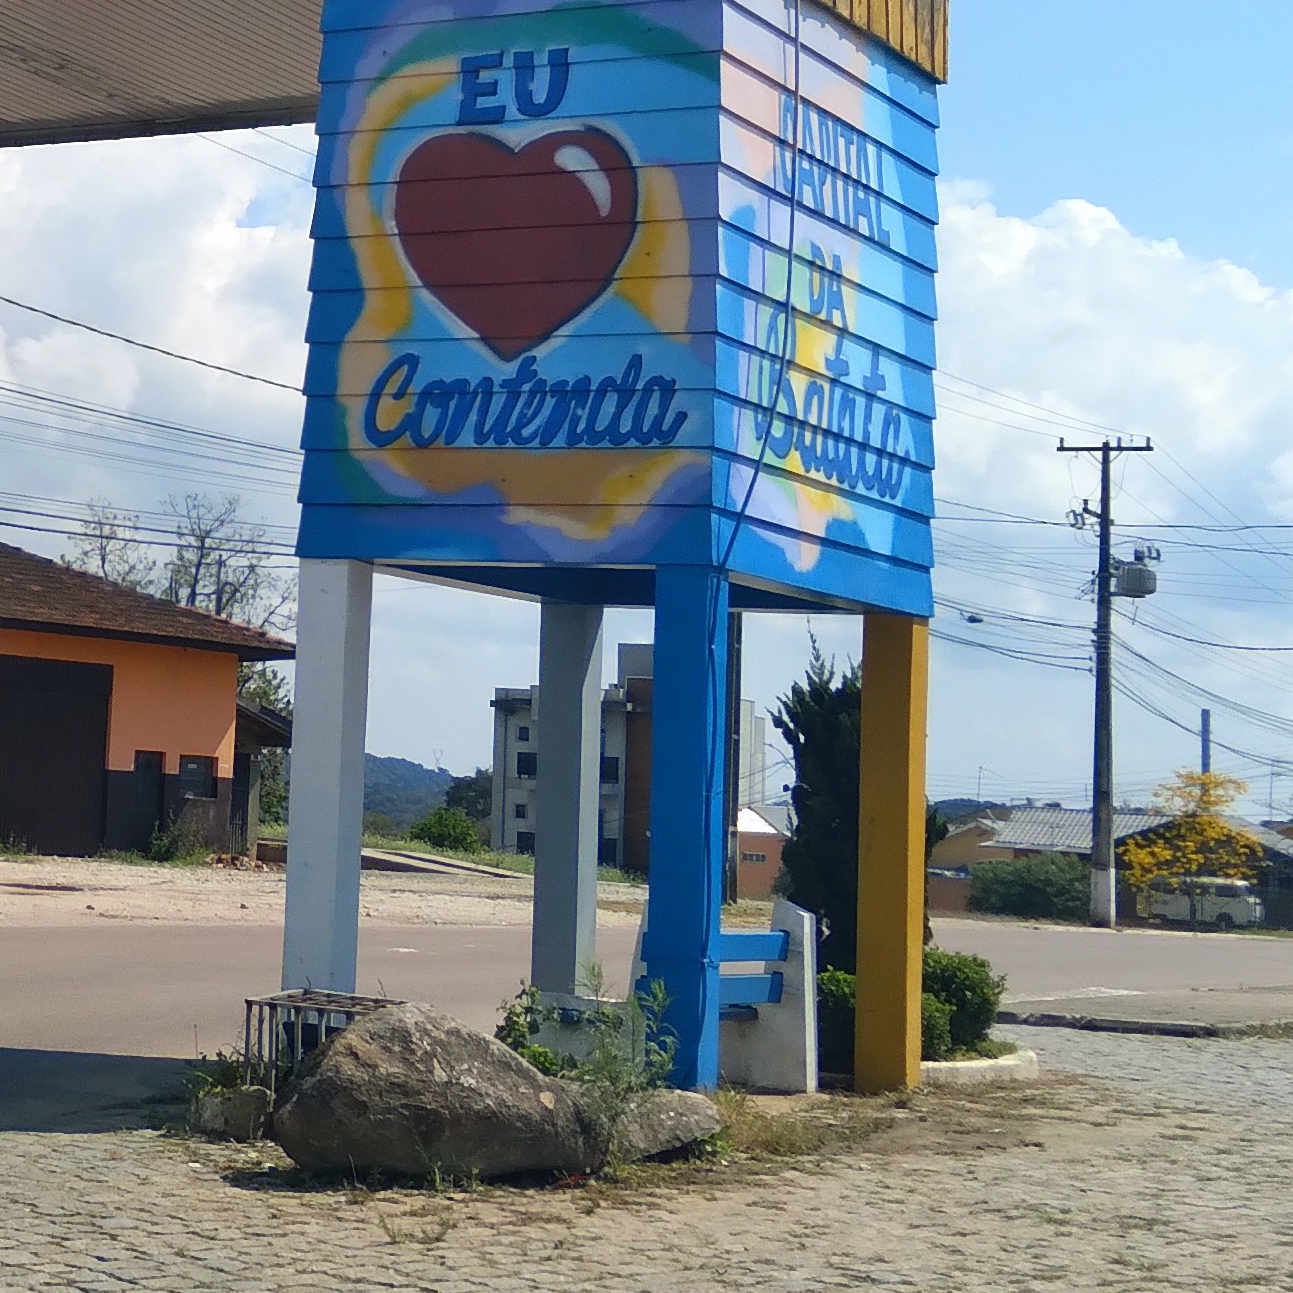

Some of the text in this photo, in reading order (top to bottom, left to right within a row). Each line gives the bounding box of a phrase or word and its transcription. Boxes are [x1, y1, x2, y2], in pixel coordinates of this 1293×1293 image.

[456, 47, 570, 126] EU
[780, 92, 891, 248] CAPITAL
[809, 240, 850, 332] DA
[363, 353, 688, 448] Contenda
[753, 303, 913, 500] Batata
